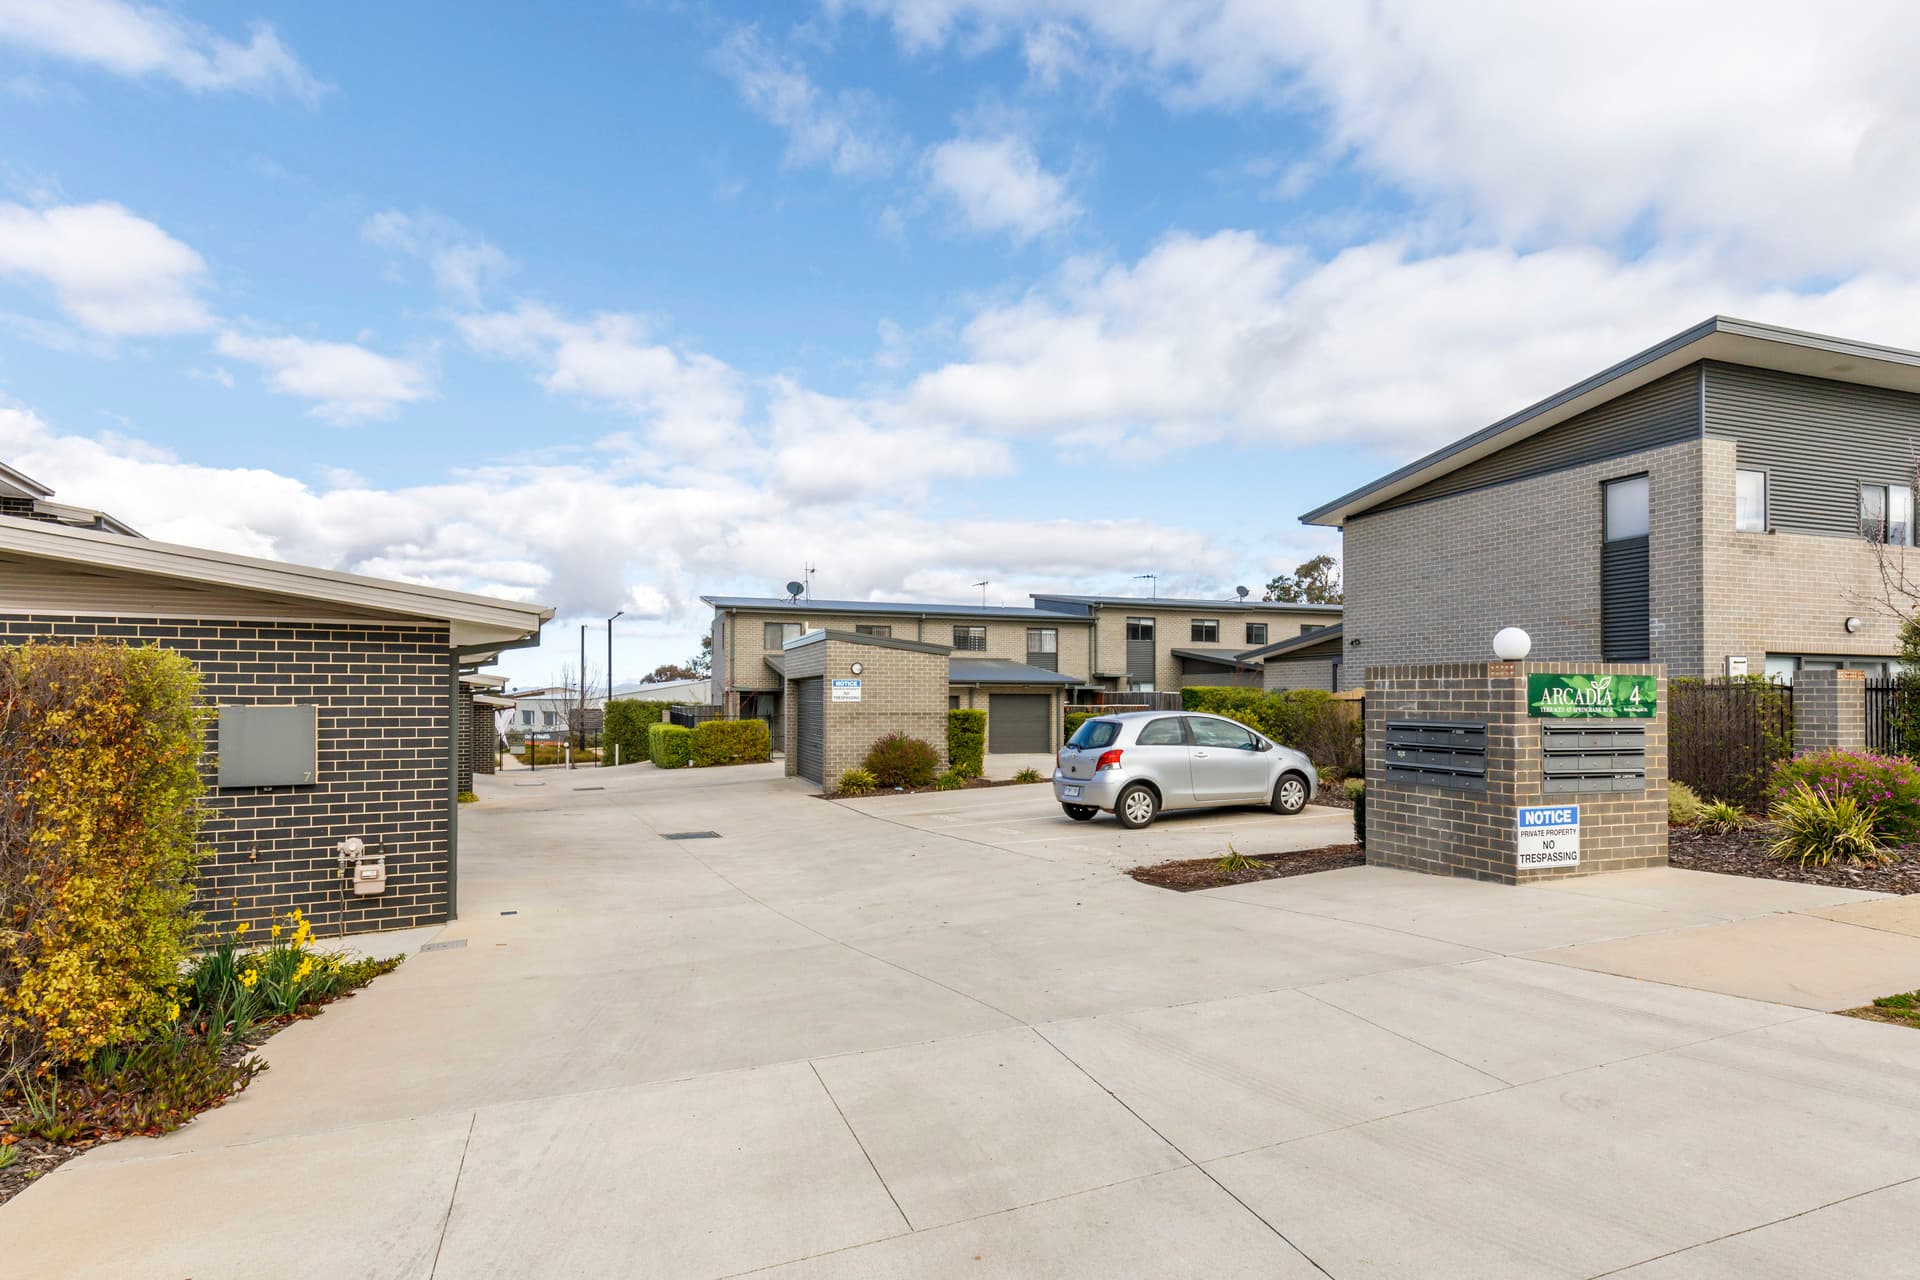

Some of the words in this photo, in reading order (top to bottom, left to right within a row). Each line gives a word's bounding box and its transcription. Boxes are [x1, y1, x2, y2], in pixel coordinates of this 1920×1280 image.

[1541, 687, 1613, 705] ARCADIA
[1629, 685, 1641, 705] 4
[303, 771, 311, 783] 7
[1525, 809, 1572, 825] NOTICE
[1520, 829, 1545, 838] PRIVATE
[1546, 828, 1577, 837] PROPERTY
[1542, 839, 1555, 850] NO
[1520, 850, 1578, 864] TRESPASSING
